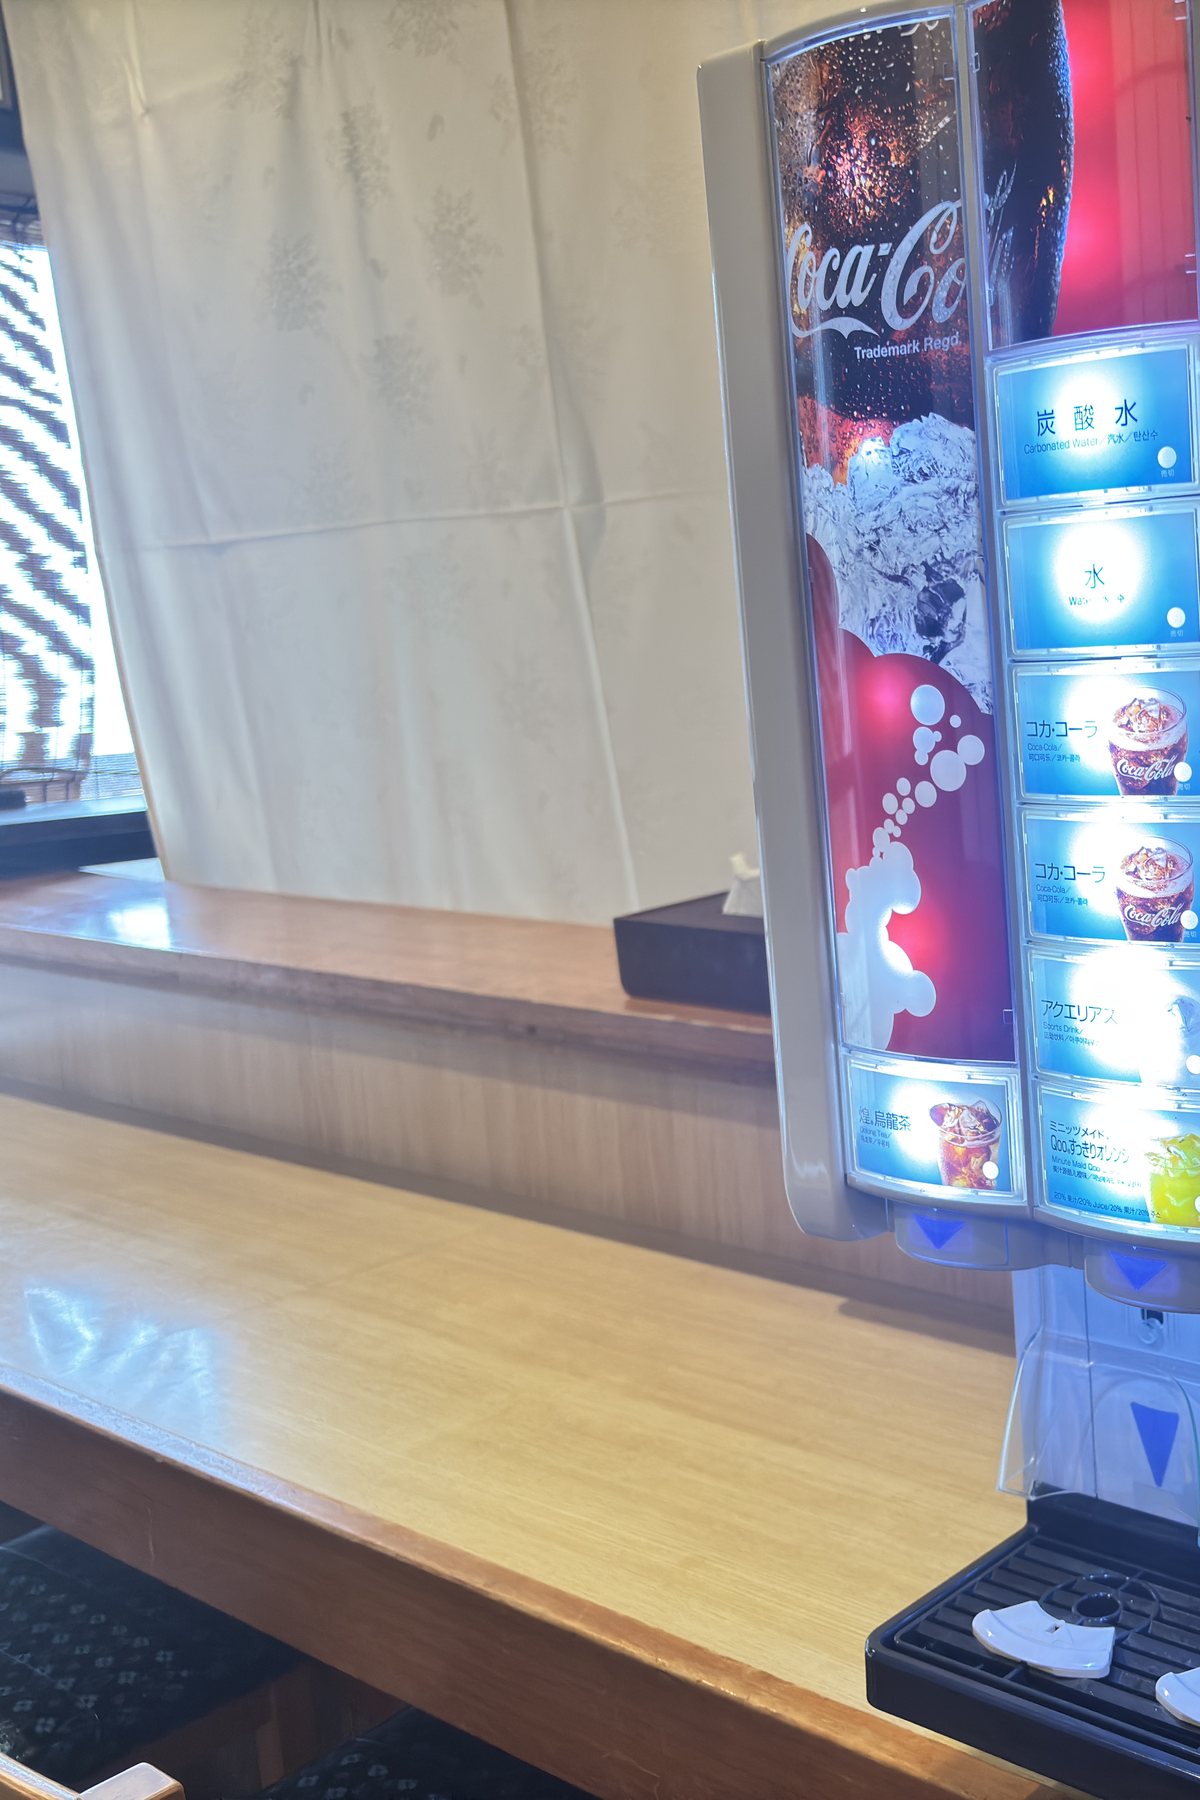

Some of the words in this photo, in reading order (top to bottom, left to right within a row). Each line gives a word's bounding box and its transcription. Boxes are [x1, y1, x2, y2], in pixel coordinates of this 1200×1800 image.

[854, 340, 919, 360] Trademark
[1036, 398, 1138, 437] 炭酸水
[1023, 438, 1070, 455] Carbonated
[1084, 563, 1105, 589] 水
[1116, 754, 1178, 781] Coca-Cola
[1124, 902, 1185, 928] Coca-Cola
[1041, 1000, 1118, 1024] アクエリアス
